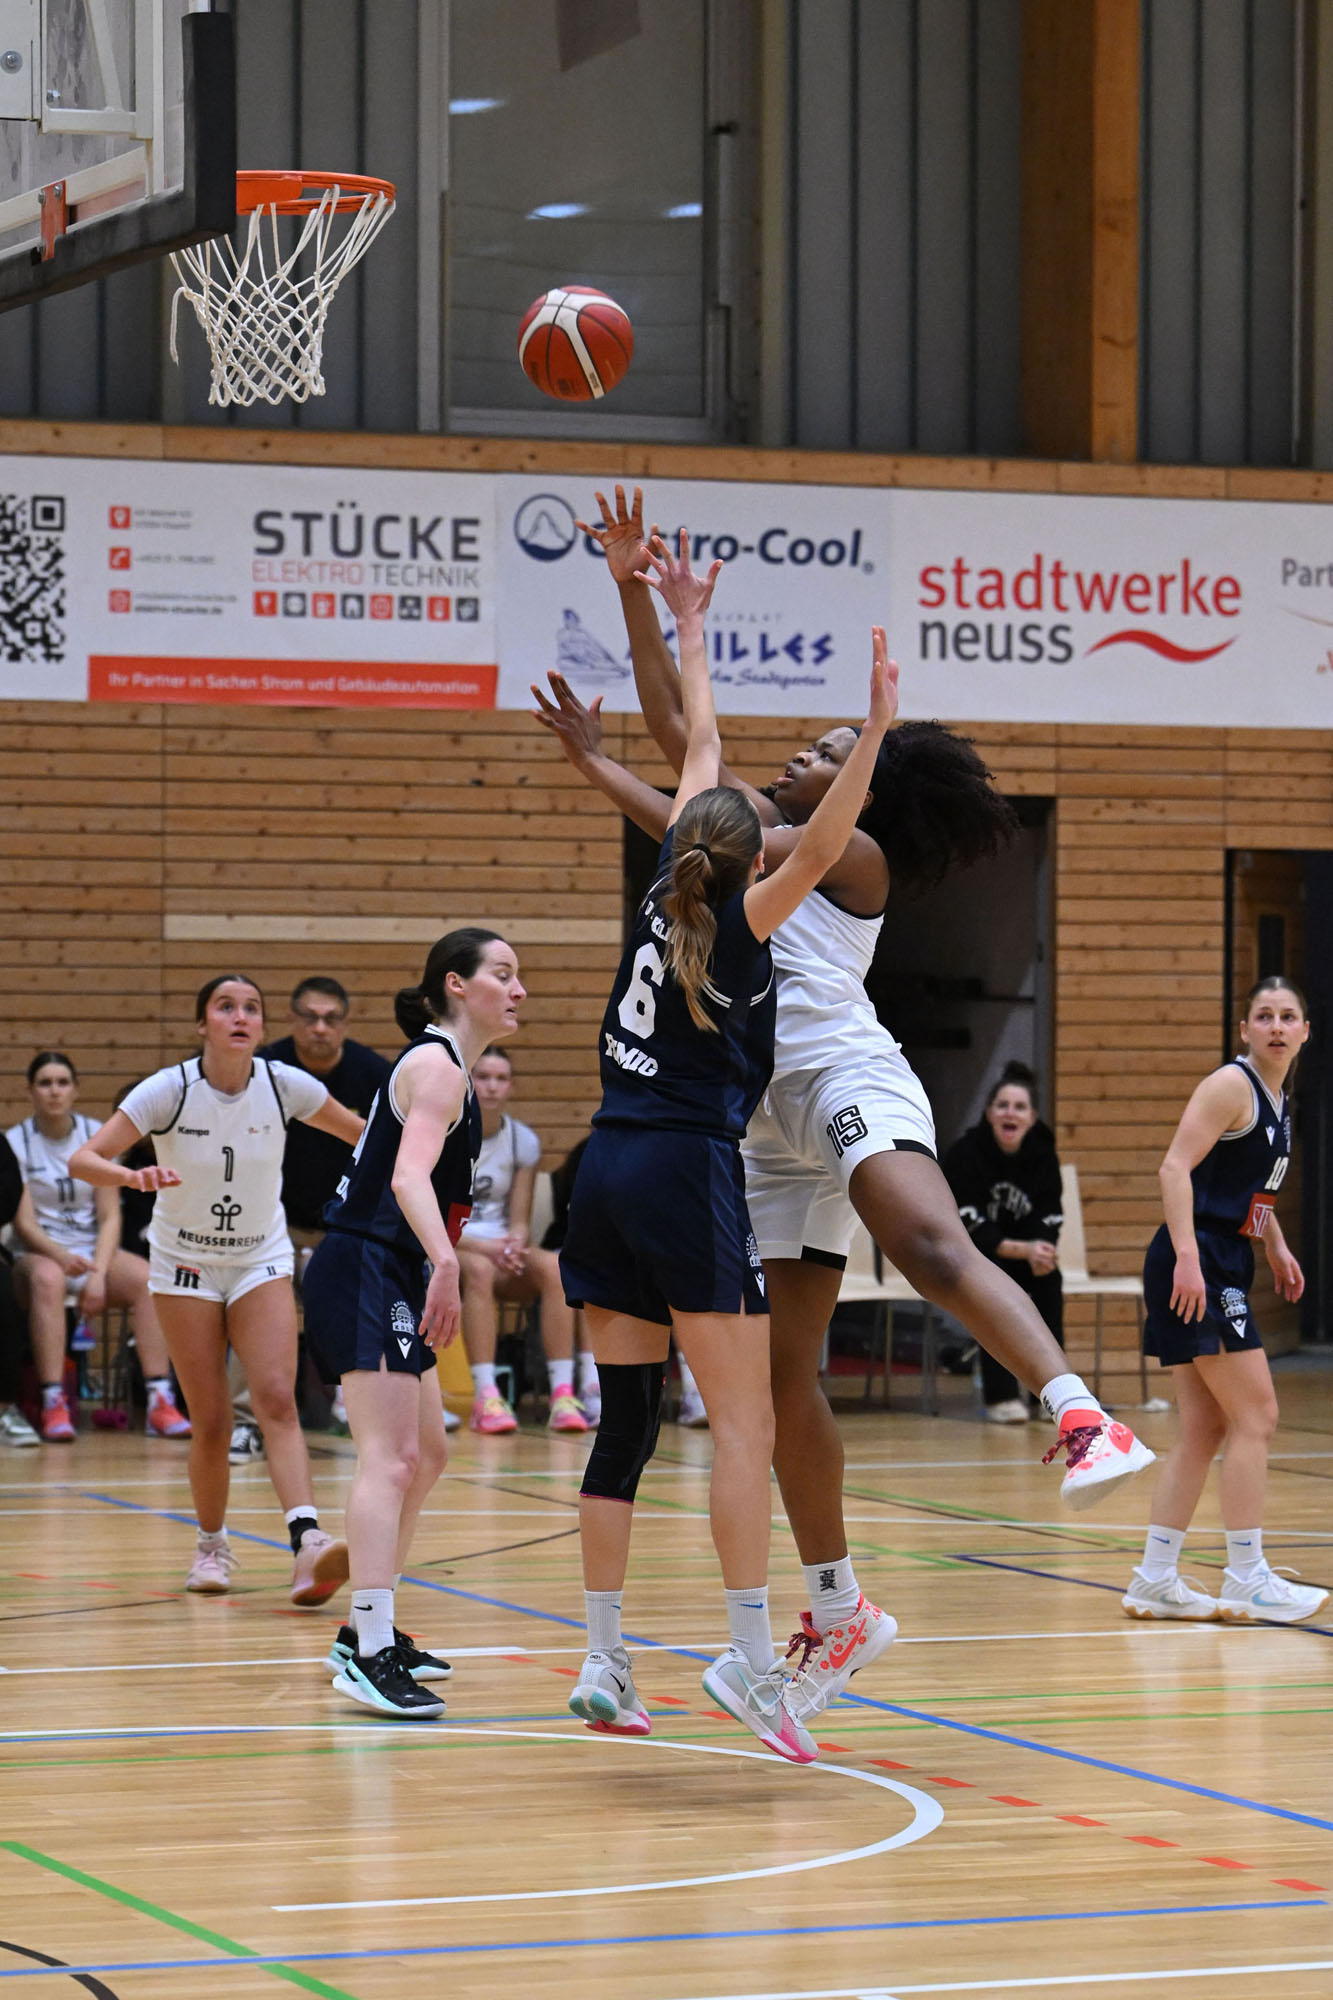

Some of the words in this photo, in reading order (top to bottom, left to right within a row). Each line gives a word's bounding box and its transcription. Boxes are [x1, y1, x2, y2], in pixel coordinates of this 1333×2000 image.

[253, 501, 481, 562] STÜCKE
[252, 560, 364, 585] ELEKTRO
[370, 563, 482, 588] TECHNIK
[918, 553, 1242, 617] stadtwerke
[920, 619, 1073, 664] neuss
[108, 671, 128, 687] Ihr
[132, 672, 186, 688] Partner
[189, 675, 204, 687] in
[206, 674, 258, 689] Sachen
[261, 674, 303, 691] Strom
[307, 678, 334, 692] und
[617, 941, 665, 1040] 6
[826, 1104, 869, 1160] 15
[222, 1146, 234, 1182] 1
[1264, 1156, 1289, 1191] 10
